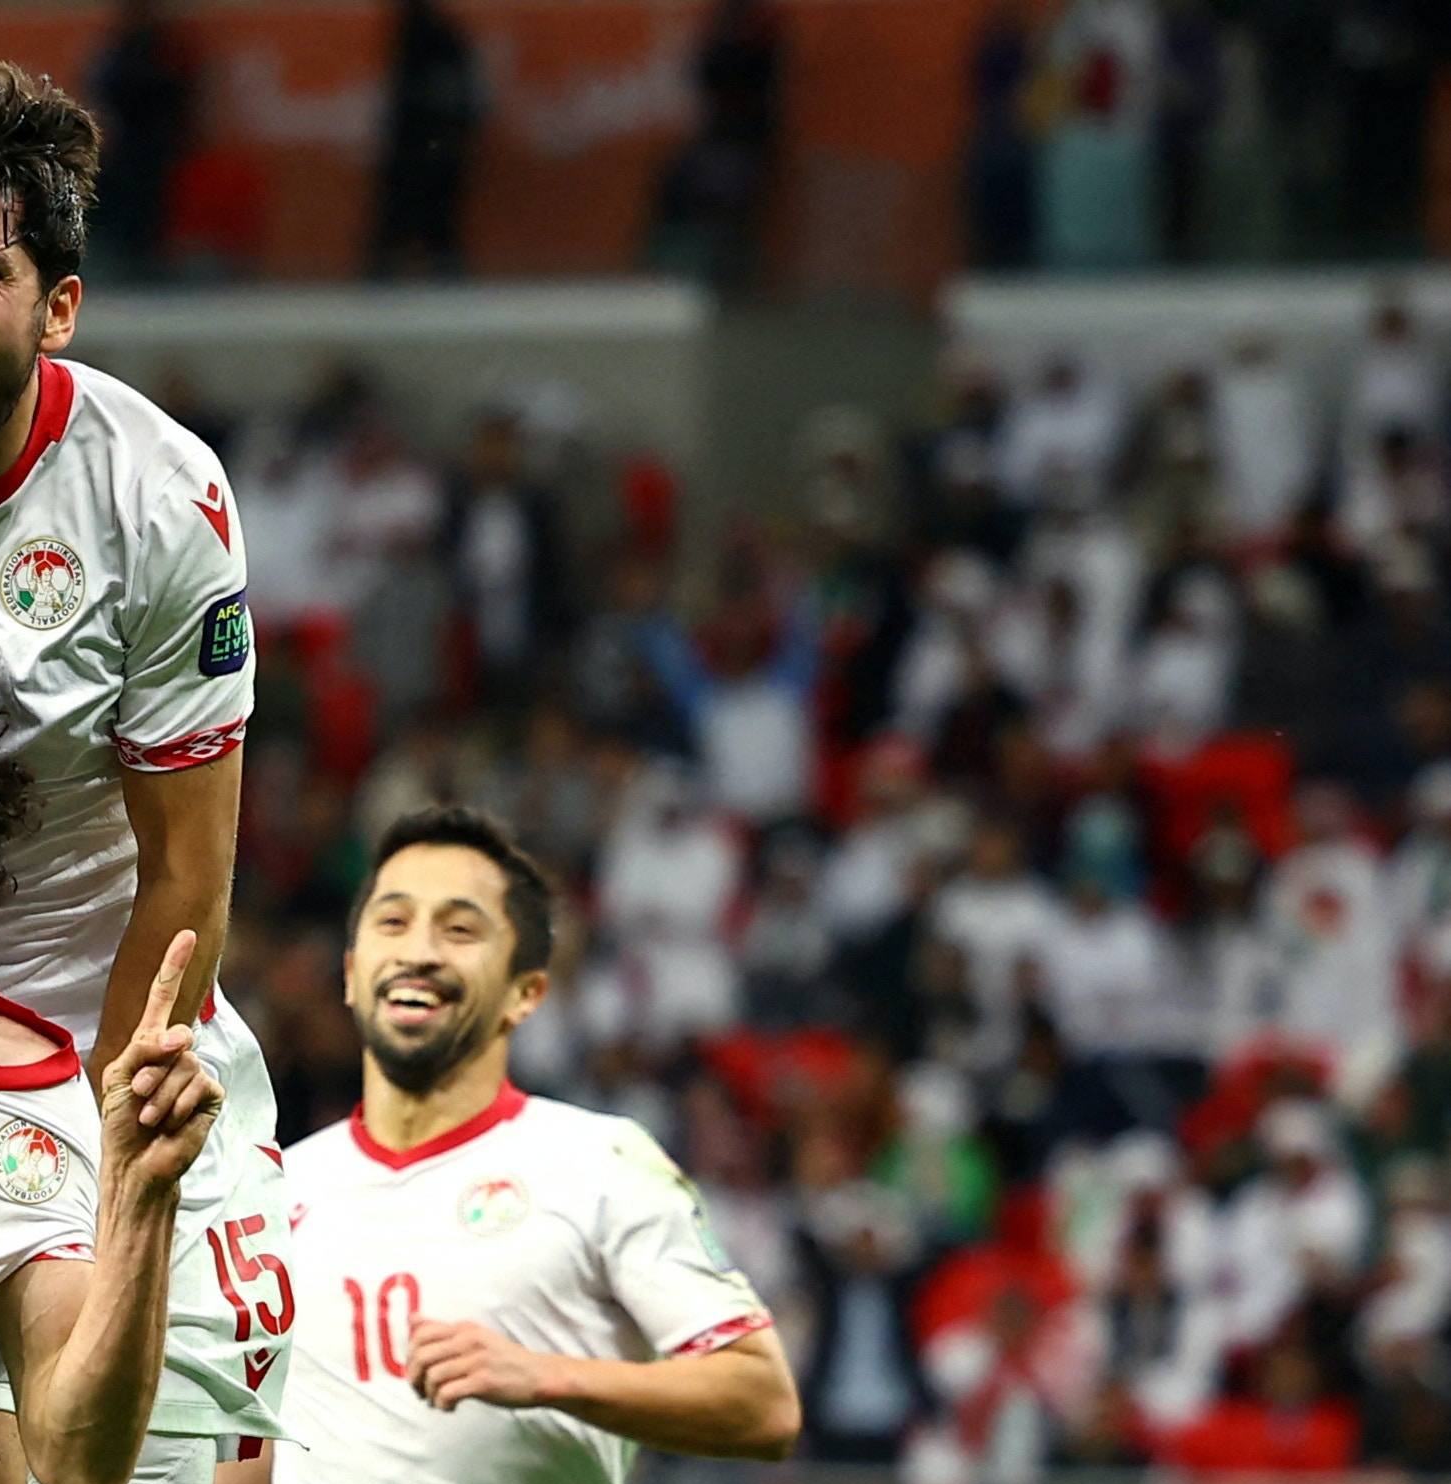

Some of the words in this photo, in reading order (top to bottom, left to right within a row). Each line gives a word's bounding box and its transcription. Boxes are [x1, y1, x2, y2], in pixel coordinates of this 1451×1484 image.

[216, 601, 241, 622] AFC
[206, 1213, 296, 1341] 15
[343, 1271, 420, 1382] 10
